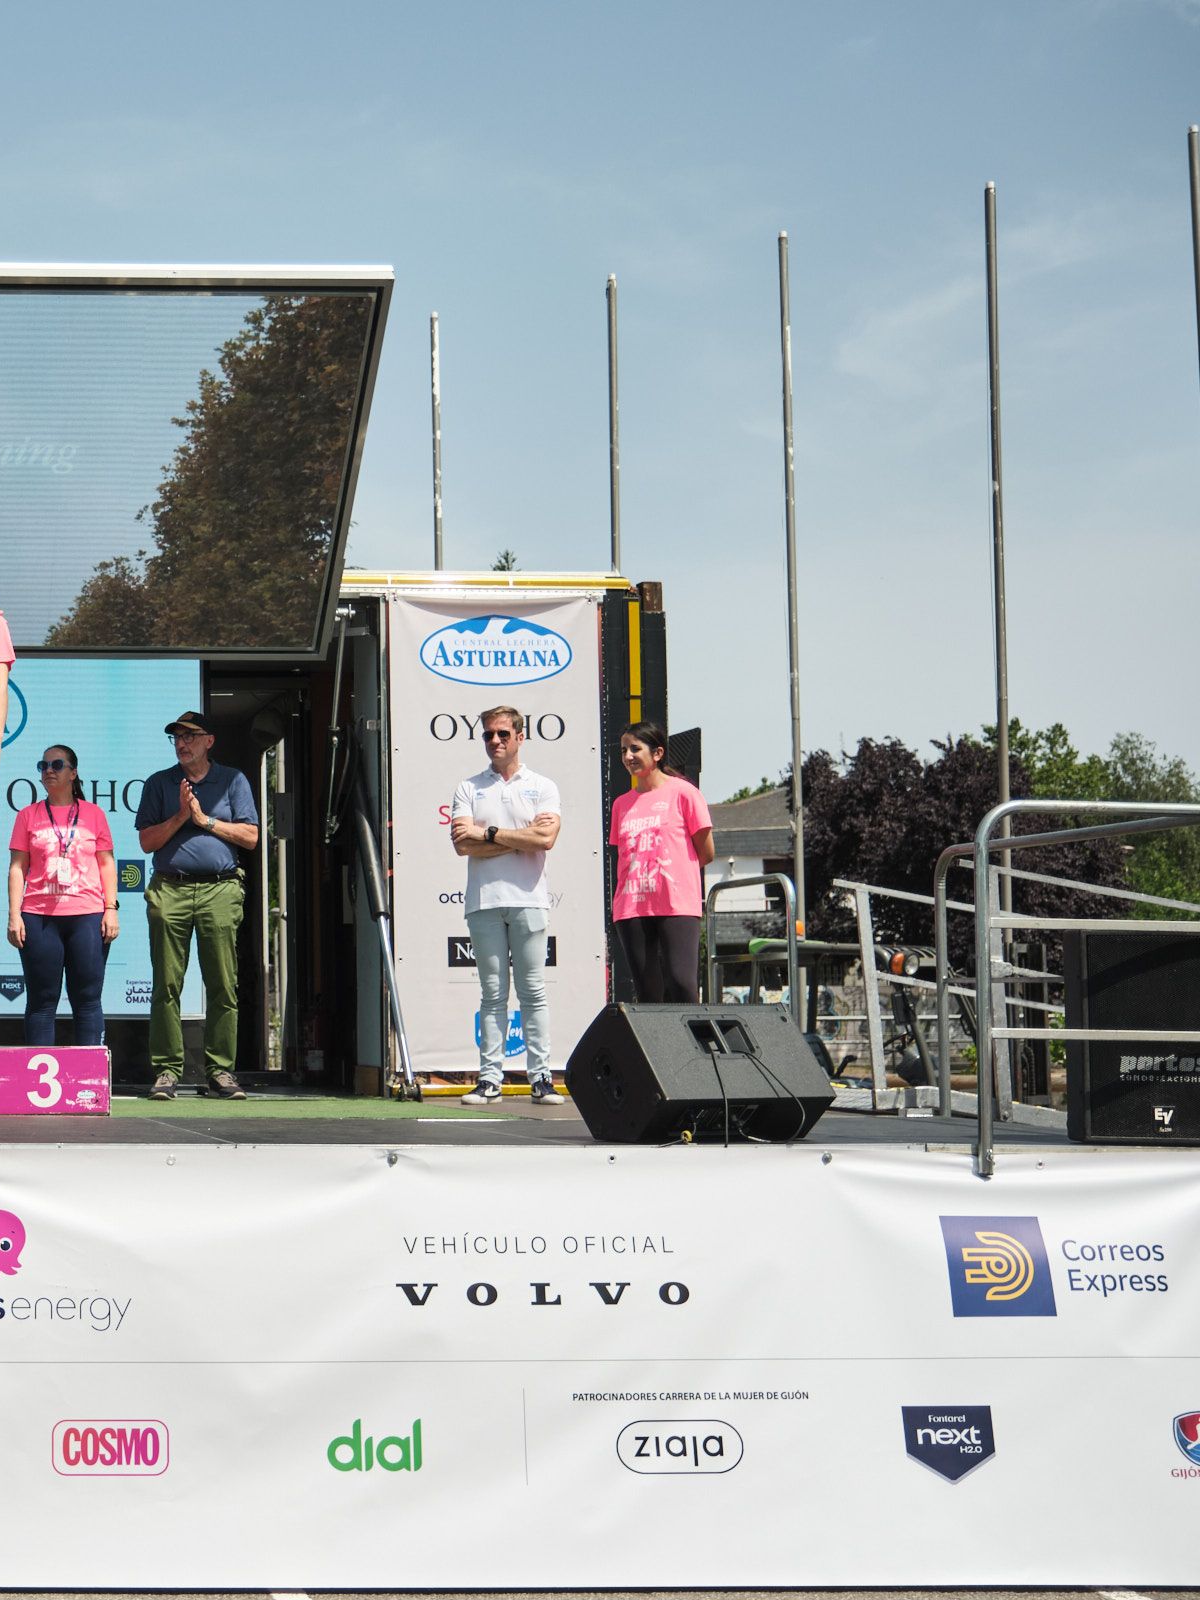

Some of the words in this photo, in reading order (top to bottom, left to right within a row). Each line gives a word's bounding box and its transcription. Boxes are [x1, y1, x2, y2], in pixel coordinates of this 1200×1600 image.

[432, 639, 562, 668] ASTURIANA
[453, 638, 502, 647] CENTRAL
[506, 638, 556, 647] LECHERA
[1, 982, 22, 990] next
[125, 996, 152, 1004] OMAN
[26, 1053, 63, 1108] 3
[1154, 1107, 1175, 1125] EV
[402, 1231, 548, 1256] VEHÍCULO
[562, 1235, 675, 1255] OFICIAL
[1060, 1238, 1166, 1263] Correos
[395, 1281, 691, 1307] VOLVO
[1066, 1268, 1170, 1298] Express
[10, 1295, 133, 1332] energy
[572, 1392, 658, 1401] PATROCINADORES
[658, 1392, 702, 1401] CARRERA
[703, 1392, 717, 1401] DE
[718, 1391, 731, 1400] LA
[732, 1391, 765, 1400] MUJER
[766, 1391, 779, 1400] DE
[780, 1389, 810, 1401] GIJÓN
[927, 1414, 967, 1424] Fontarel
[62, 1426, 160, 1467] COSMO
[326, 1417, 423, 1473] dial
[916, 1425, 982, 1446] next
[959, 1445, 983, 1454] H2.0
[1170, 1465, 1200, 1481] GIJÓ
